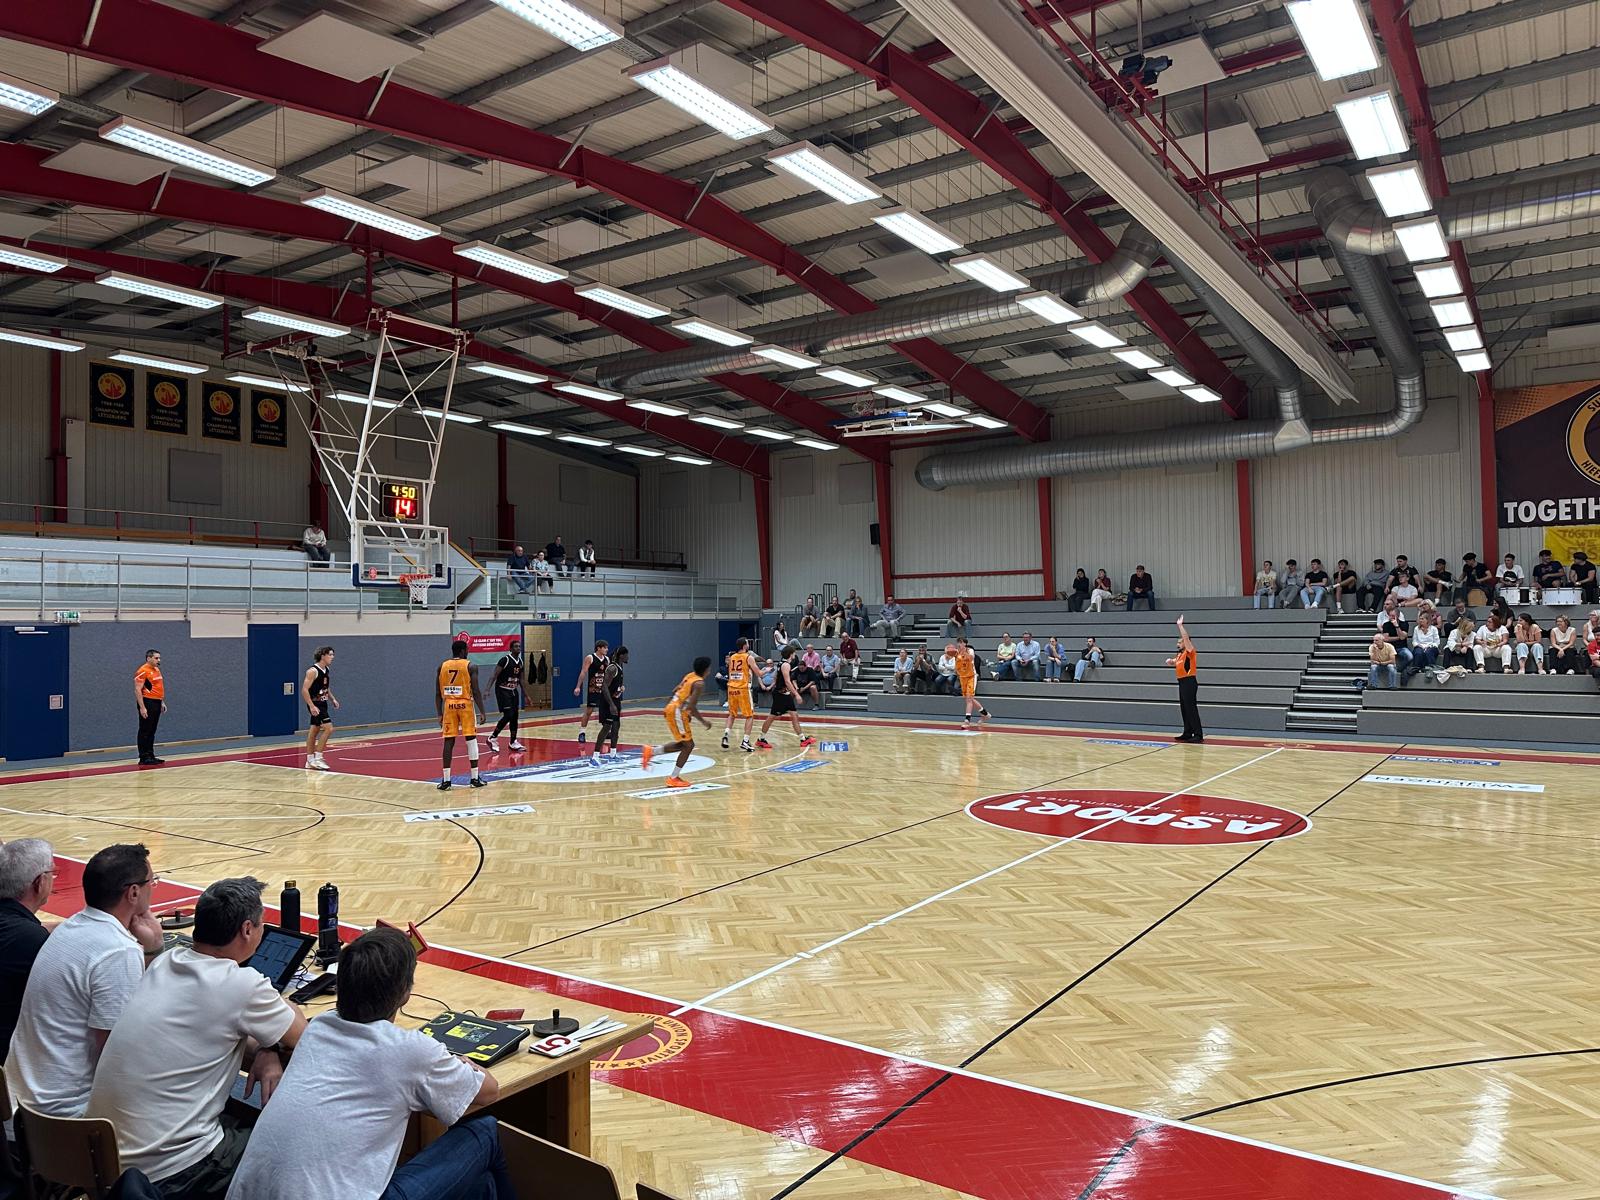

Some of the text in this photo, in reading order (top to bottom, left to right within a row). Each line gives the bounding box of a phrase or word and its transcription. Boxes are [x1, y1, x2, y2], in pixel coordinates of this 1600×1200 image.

[1581, 460, 1600, 478] HIEF
[391, 485, 416, 499] 4:50
[395, 499, 411, 516] 14
[731, 660, 743, 671] 12
[448, 669, 459, 684] 7
[984, 798, 1282, 835] ASPORT
[536, 1037, 571, 1052] 5
